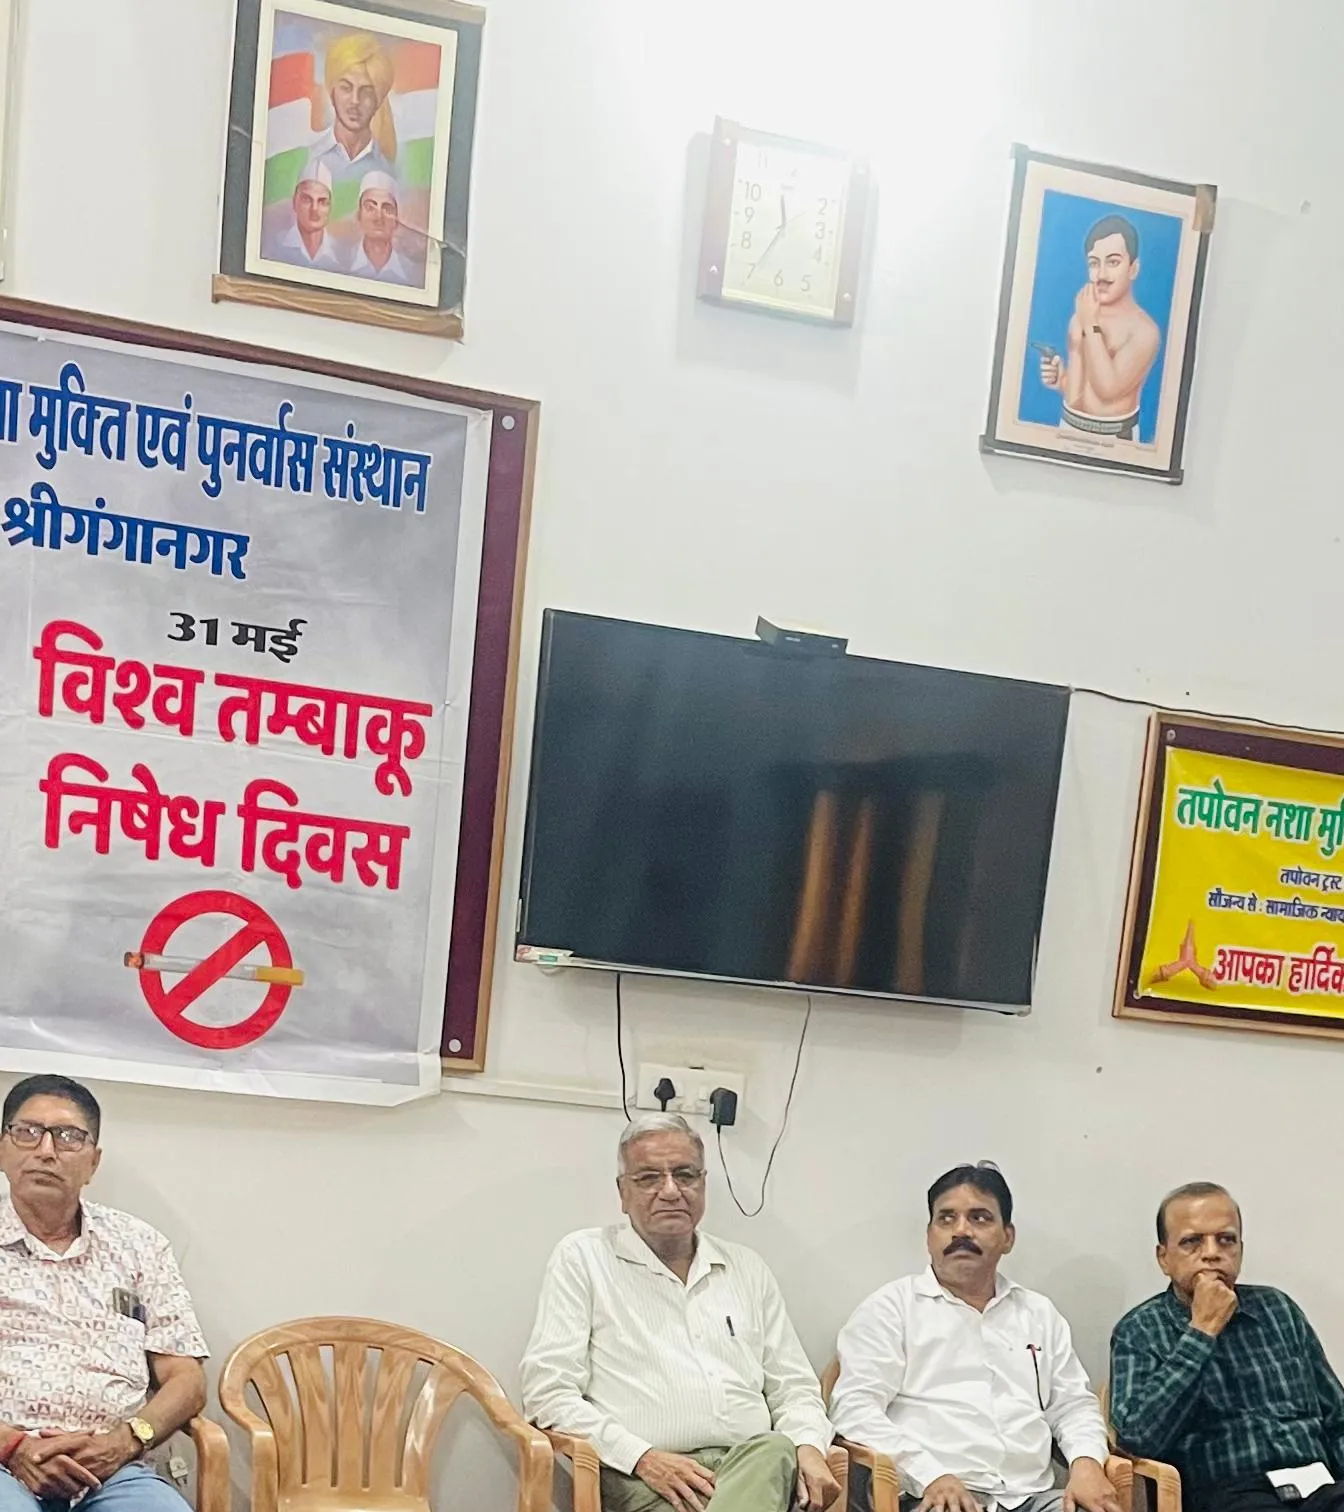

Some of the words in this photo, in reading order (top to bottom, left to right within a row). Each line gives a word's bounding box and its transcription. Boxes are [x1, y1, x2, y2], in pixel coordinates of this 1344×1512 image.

[745, 181, 761, 201] 10
[744, 206, 755, 224] 9
[741, 231, 752, 249] 8
[773, 269, 784, 286] 6
[29, 363, 130, 470] मुक्ति
[136, 393, 192, 472] एवं
[197, 401, 317, 498] पुनर्वास
[322, 423, 432, 512] संस्थान
[1, 481, 250, 580] श्रीगंगानगर
[167, 612, 219, 646] 31
[231, 618, 308, 663] मई
[33, 619, 204, 737] विश्व
[214, 672, 433, 797] तम्बाकू
[39, 752, 225, 868] निषेध
[237, 778, 411, 890] दिवस
[1177, 778, 1263, 834] तपोवन
[1265, 801, 1316, 841] नशा
[1280, 866, 1321, 887] तपोवन
[1322, 874, 1343, 892] ट्रस्ट
[1208, 888, 1246, 911] सौजन्य
[1247, 893, 1258, 912] से
[1265, 896, 1318, 919] सामाजिक
[1215, 948, 1285, 987] आपका
